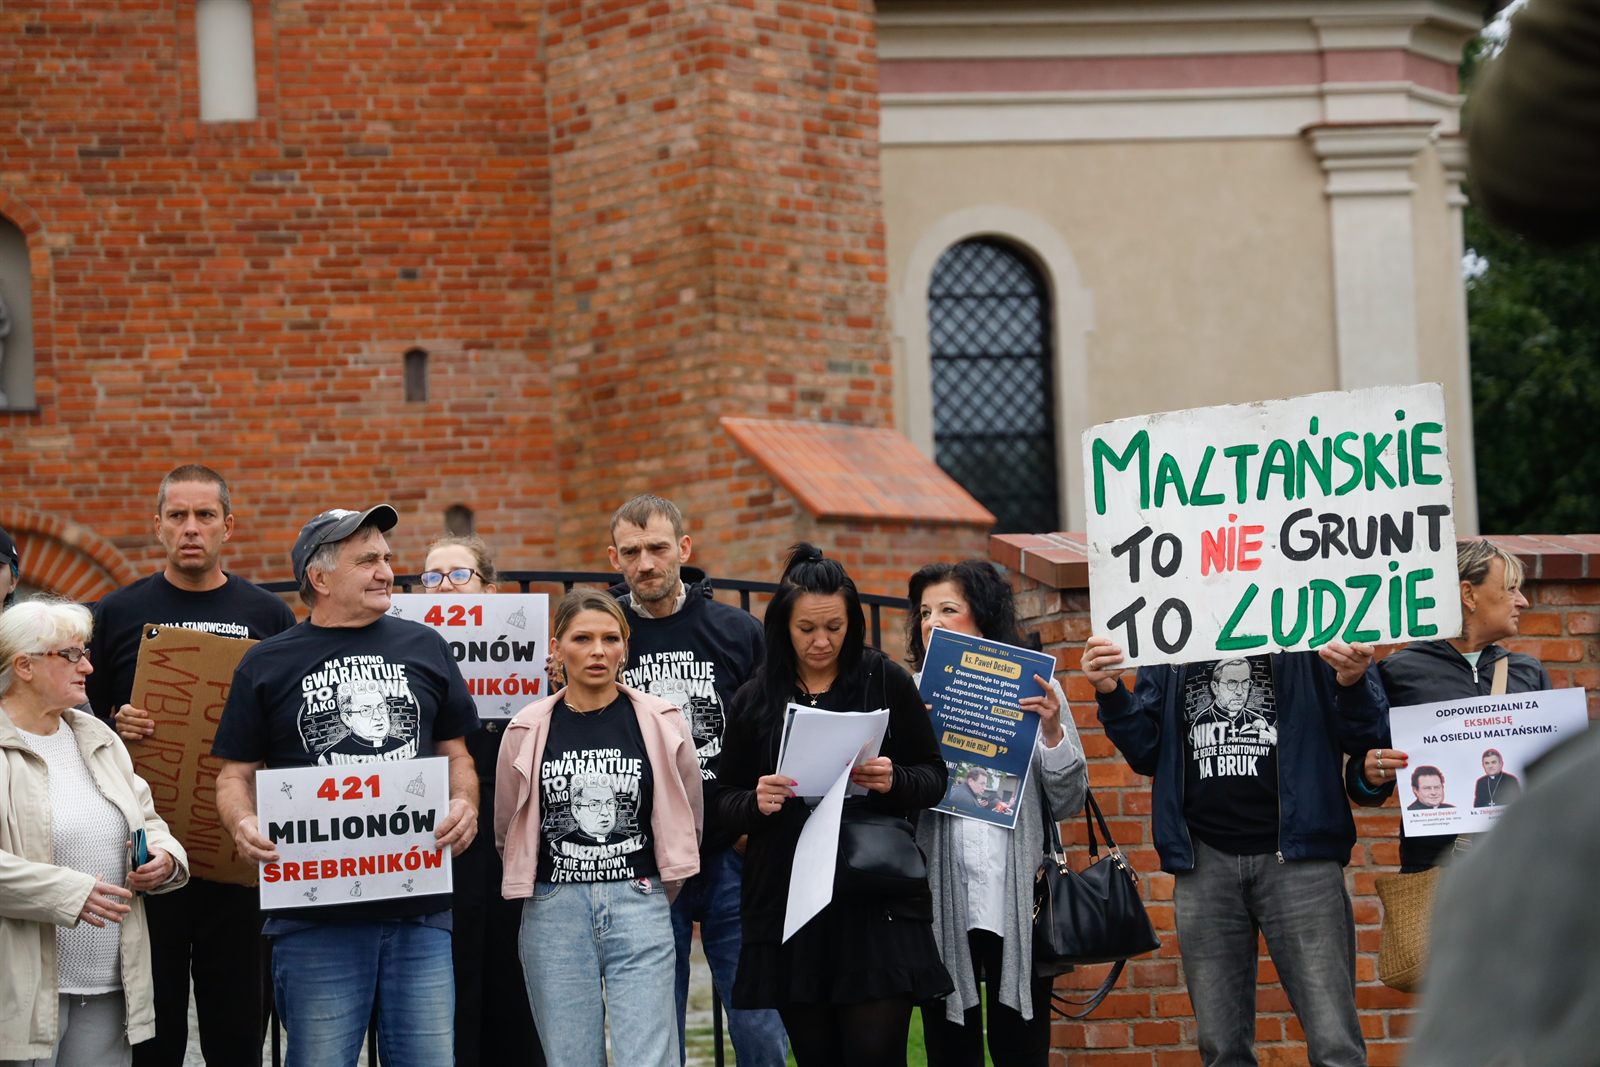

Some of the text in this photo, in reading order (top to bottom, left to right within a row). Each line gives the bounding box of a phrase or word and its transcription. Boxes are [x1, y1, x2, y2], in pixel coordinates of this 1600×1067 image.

[1111, 525, 1183, 583] TO
[1279, 504, 1451, 562] GRUNT
[424, 604, 483, 627] 421
[1106, 596, 1193, 659] TO
[448, 634, 536, 663] ONÓW
[640, 650, 694, 665] NA PEWNO
[325, 655, 384, 670] NA PEWNO
[964, 654, 974, 664] ks.
[974, 656, 993, 669] Paweł
[302, 663, 409, 692] GWARANTUJĘ
[622, 661, 716, 688] GWARANTUJĘ
[302, 679, 415, 705] TO GŁOWĄ
[649, 678, 718, 705] GŁOWĄ
[945, 685, 983, 700] duszpasterz
[983, 695, 999, 706] tego
[953, 678, 968, 687] jako
[968, 682, 1000, 695] proboszcz
[1003, 689, 1018, 699] jako
[1000, 680, 1020, 691] głową
[306, 699, 336, 715] JAKO
[963, 699, 984, 711] mowy
[1435, 700, 1539, 718] ODPOWIEDZIALNI ZA
[940, 712, 971, 725] wystawia
[980, 721, 996, 732] bruk
[995, 726, 1017, 738] rzeczy
[951, 705, 985, 719] przyjeżdża
[985, 715, 1016, 727] komornik
[1463, 715, 1513, 728] EKSMISJĘ
[947, 734, 990, 753] Mowy nie ma!
[988, 734, 1007, 743] sobie.
[1193, 721, 1230, 750] NIKT
[1423, 733, 1438, 744] NA
[1440, 731, 1482, 742] OSIEDLU
[1484, 725, 1552, 739] MALTAŃSKIM
[563, 748, 622, 760] NA PEWNO
[1219, 744, 1270, 757] EKSMITOWANY
[541, 758, 643, 780] GWARANTUJĘ
[1199, 755, 1258, 780] NA BRUK
[317, 774, 380, 801] 421
[541, 773, 640, 801] TO GŁOWĄ
[547, 790, 569, 804] JAKO
[268, 804, 436, 845] MILIONÓW
[263, 845, 443, 884] SREBRNIKÓW
[563, 857, 579, 870] NIE
[580, 860, 595, 871] MA
[597, 856, 627, 870] MOWY
